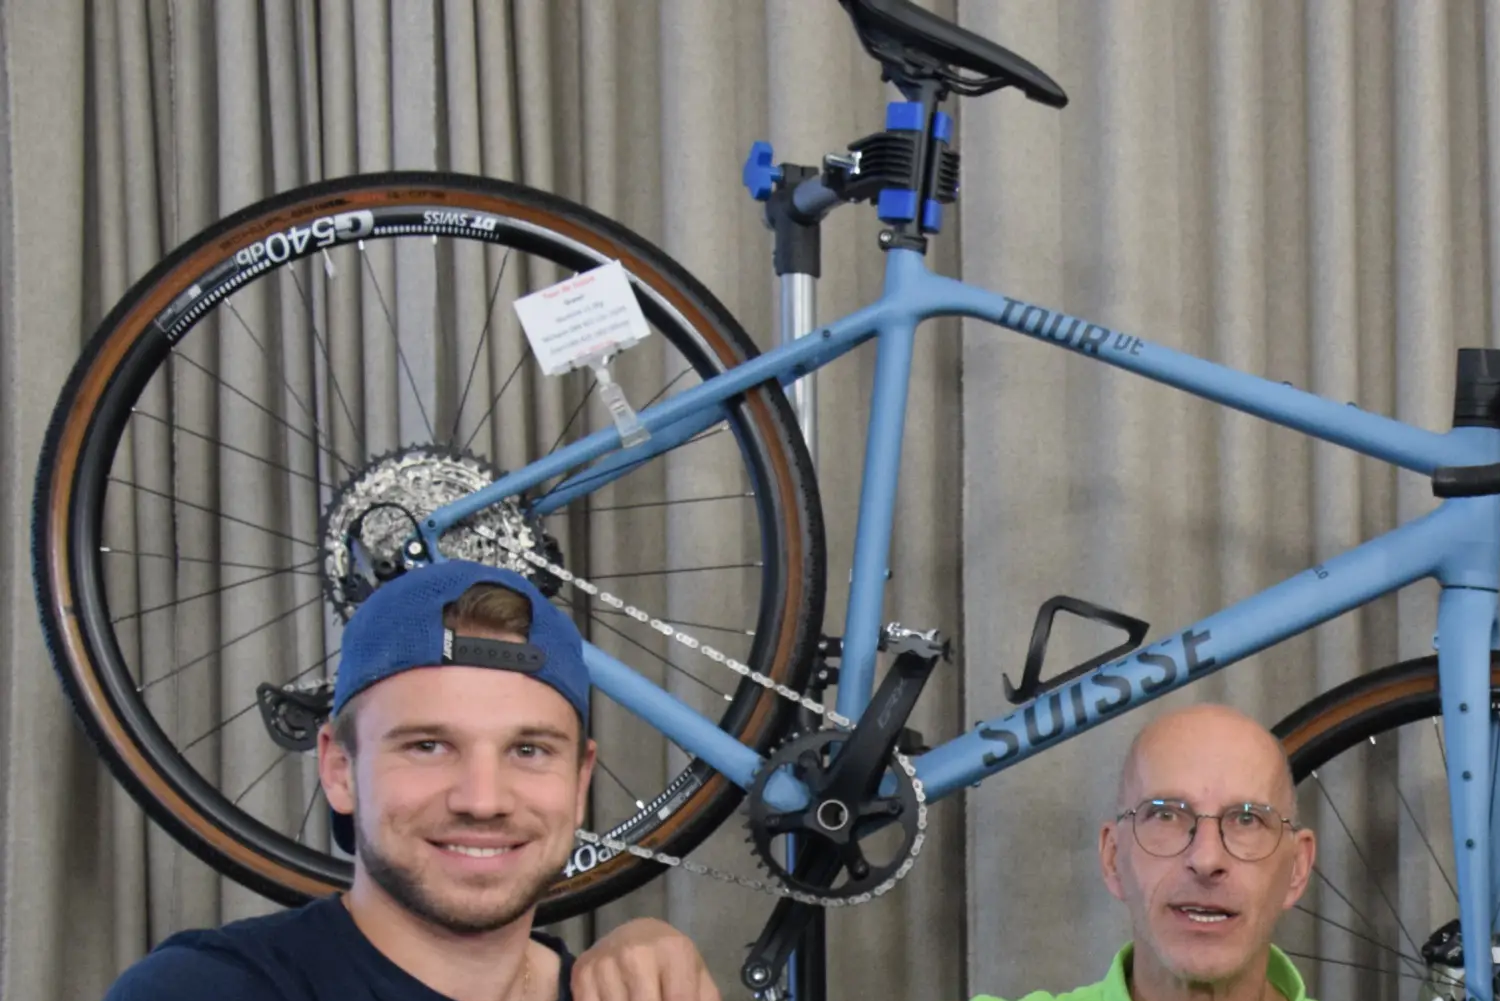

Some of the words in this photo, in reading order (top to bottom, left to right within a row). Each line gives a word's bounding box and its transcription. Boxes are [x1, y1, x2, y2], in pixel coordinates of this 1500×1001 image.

[423, 209, 469, 228] SWISS
[470, 215, 498, 231] DT
[1000, 296, 1111, 353] TOUR
[1113, 333, 1144, 355] DE
[978, 629, 1217, 768] SUISSE
